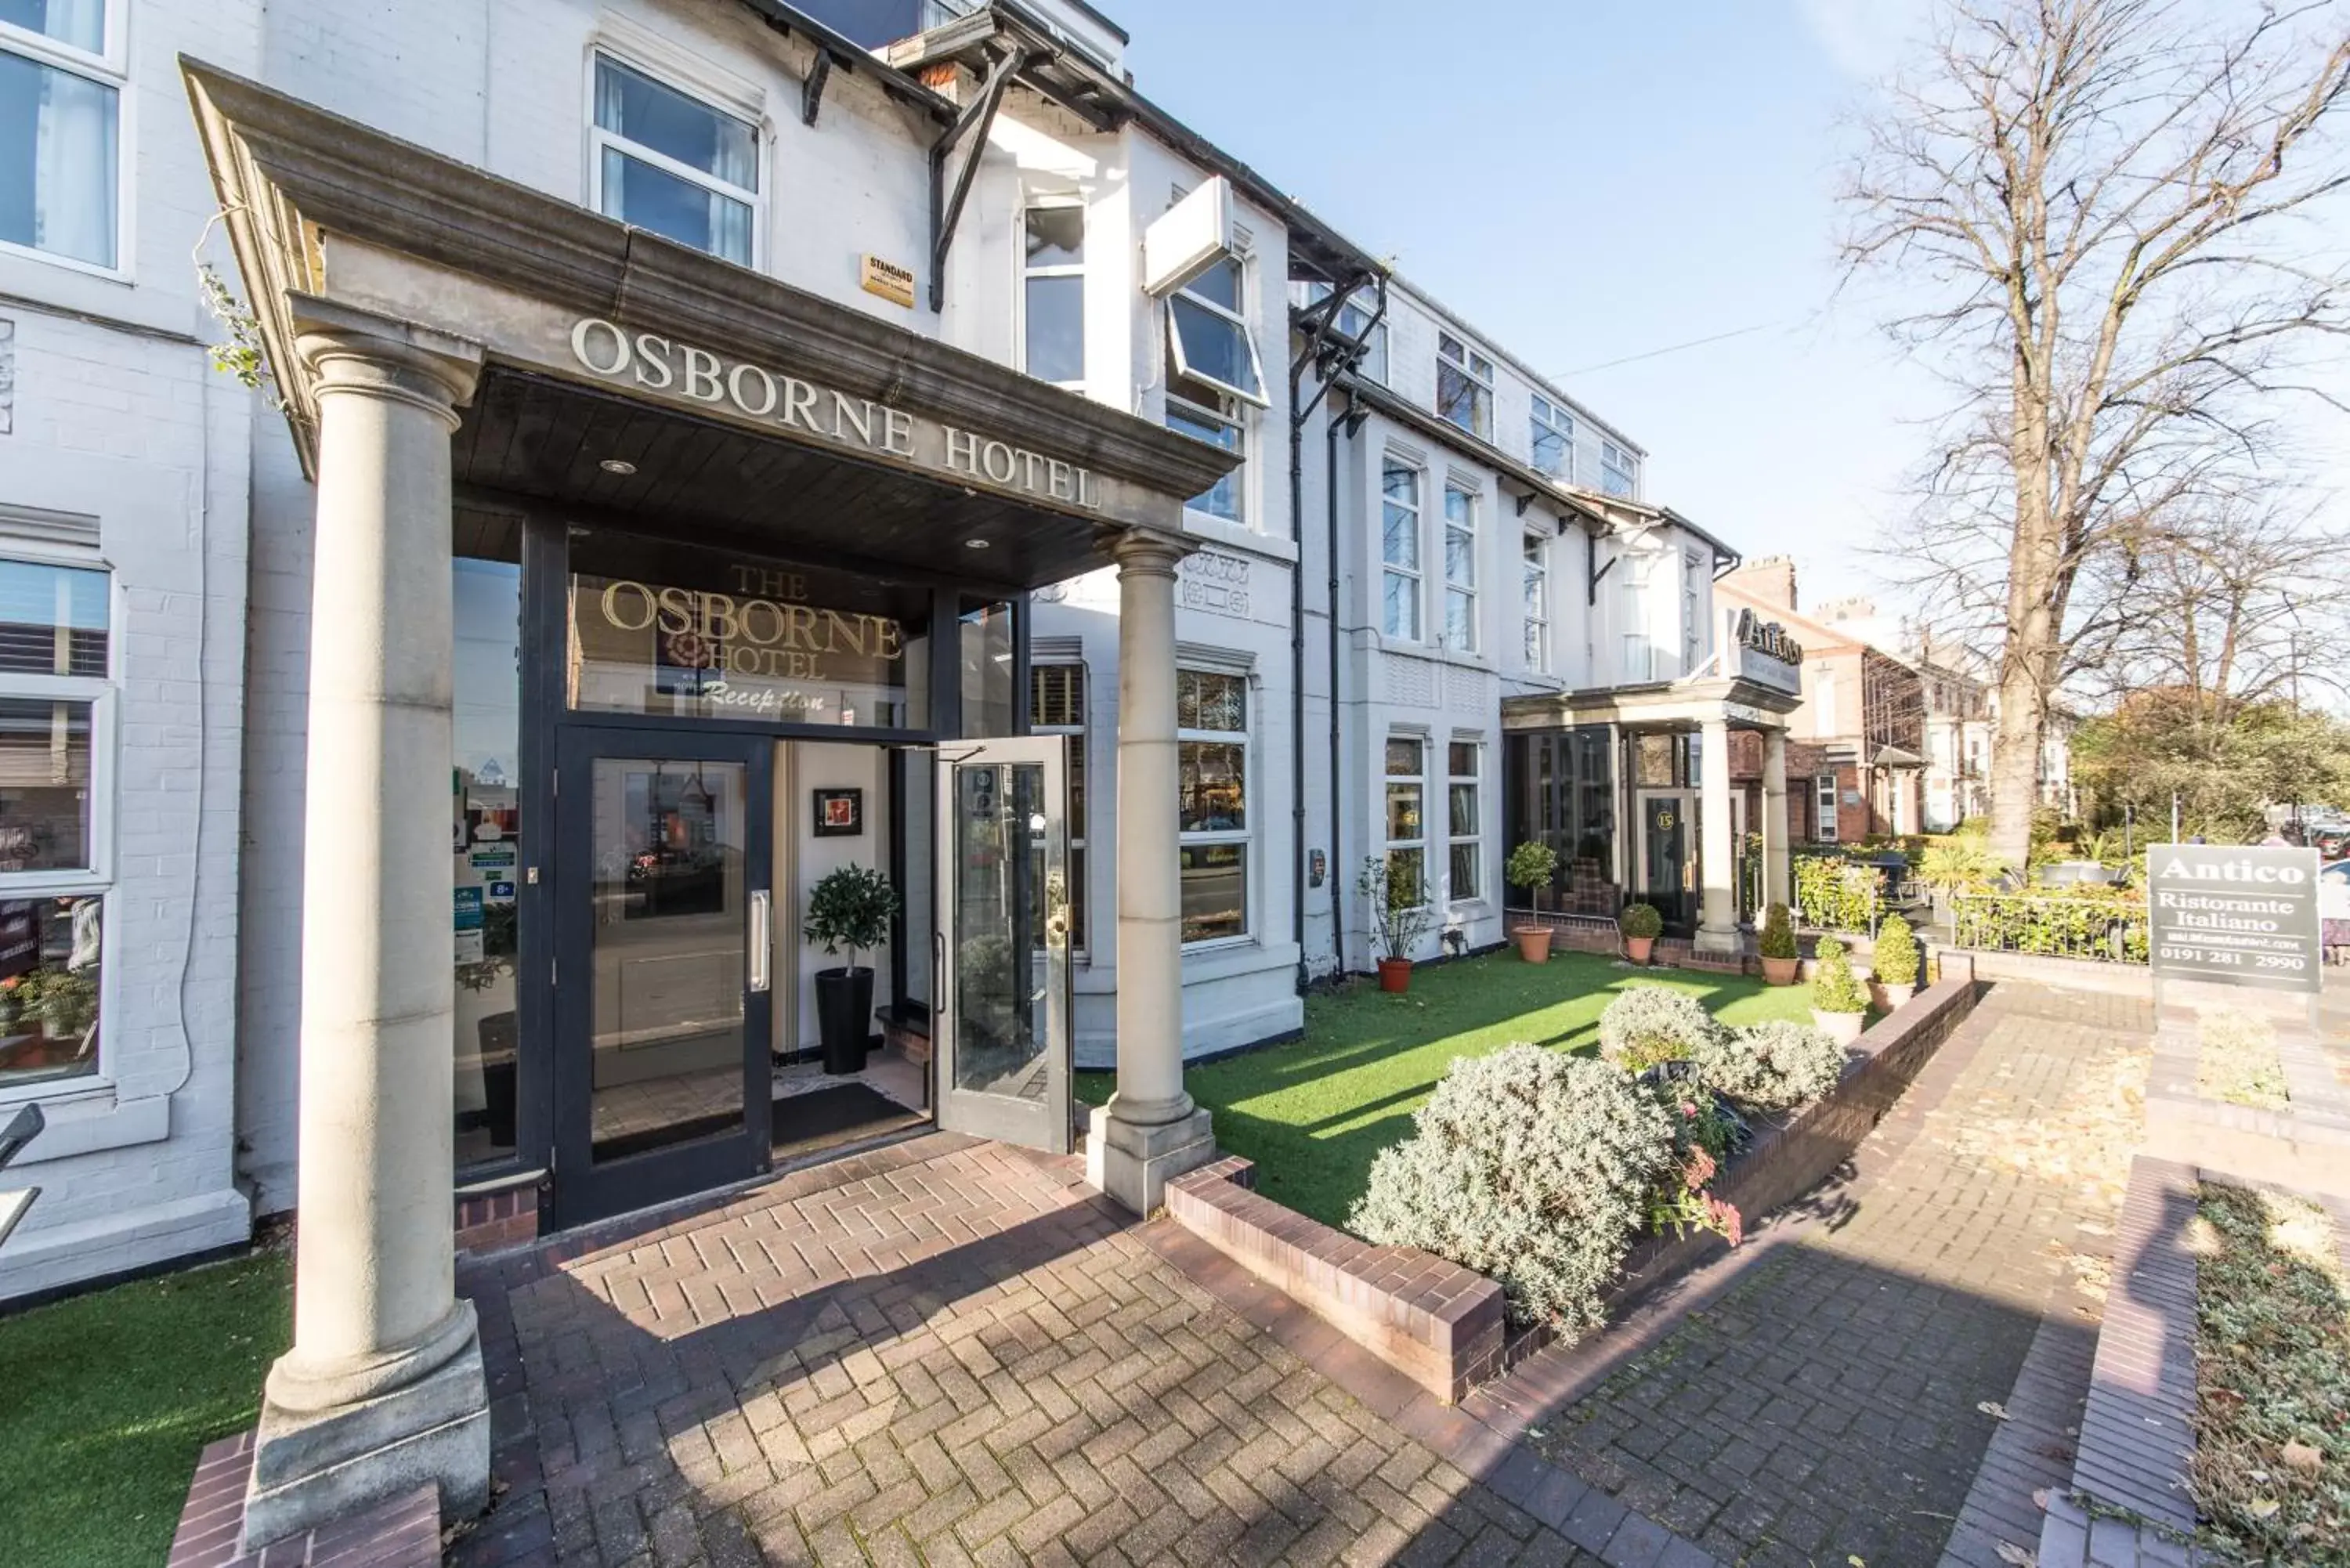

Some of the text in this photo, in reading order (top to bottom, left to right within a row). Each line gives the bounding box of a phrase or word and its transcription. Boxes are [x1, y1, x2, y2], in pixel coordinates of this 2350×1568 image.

[870, 257, 913, 283] STANDARD
[571, 318, 1100, 508] OSBORNE HOTEL
[731, 564, 808, 600] THE
[601, 580, 902, 659] OSBORNE
[707, 644, 826, 679] HOTEL
[702, 681, 825, 714] Reception
[2160, 857, 2305, 883] Antico
[2158, 891, 2294, 915] Ristorante
[2176, 911, 2278, 932] Italiano
[2160, 947, 2305, 970] 0191 281 2990
